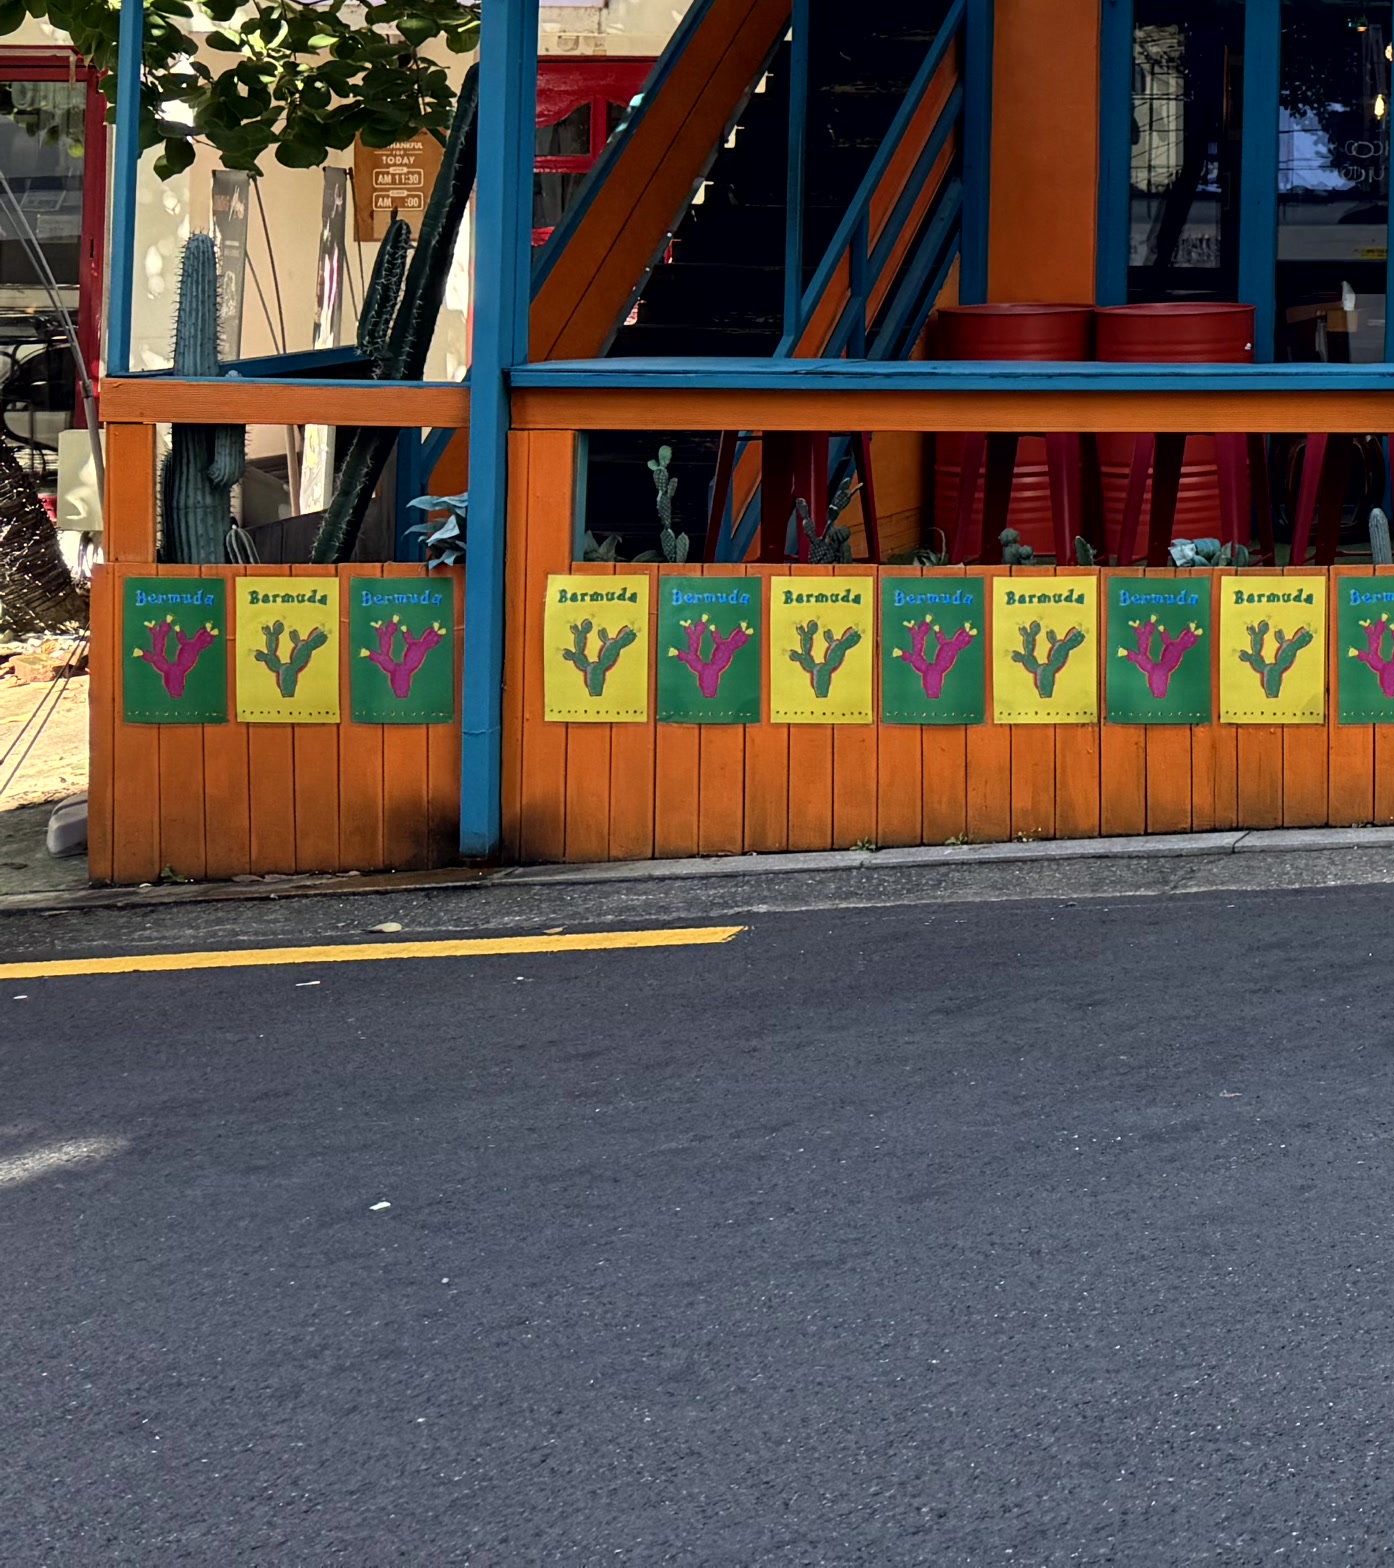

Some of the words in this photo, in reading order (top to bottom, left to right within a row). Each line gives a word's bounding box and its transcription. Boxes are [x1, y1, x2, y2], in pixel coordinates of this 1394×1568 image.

[387, 142, 424, 150] HANKFUL
[381, 156, 416, 165] TODAY
[377, 174, 392, 184] AM
[395, 174, 419, 184] 11:30
[377, 197, 392, 207] AM
[135, 589, 214, 606] Bermuda
[248, 589, 329, 605] Bermuda
[361, 589, 443, 606] Bermuda
[558, 587, 638, 604] Bermuda
[672, 588, 750, 606] Bermuda
[782, 588, 861, 606] Bermuda
[893, 589, 974, 606] Bermuda
[1005, 588, 1086, 606] Bermuda
[1119, 588, 1199, 606] Bermuda
[1233, 588, 1314, 606] Bermuda
